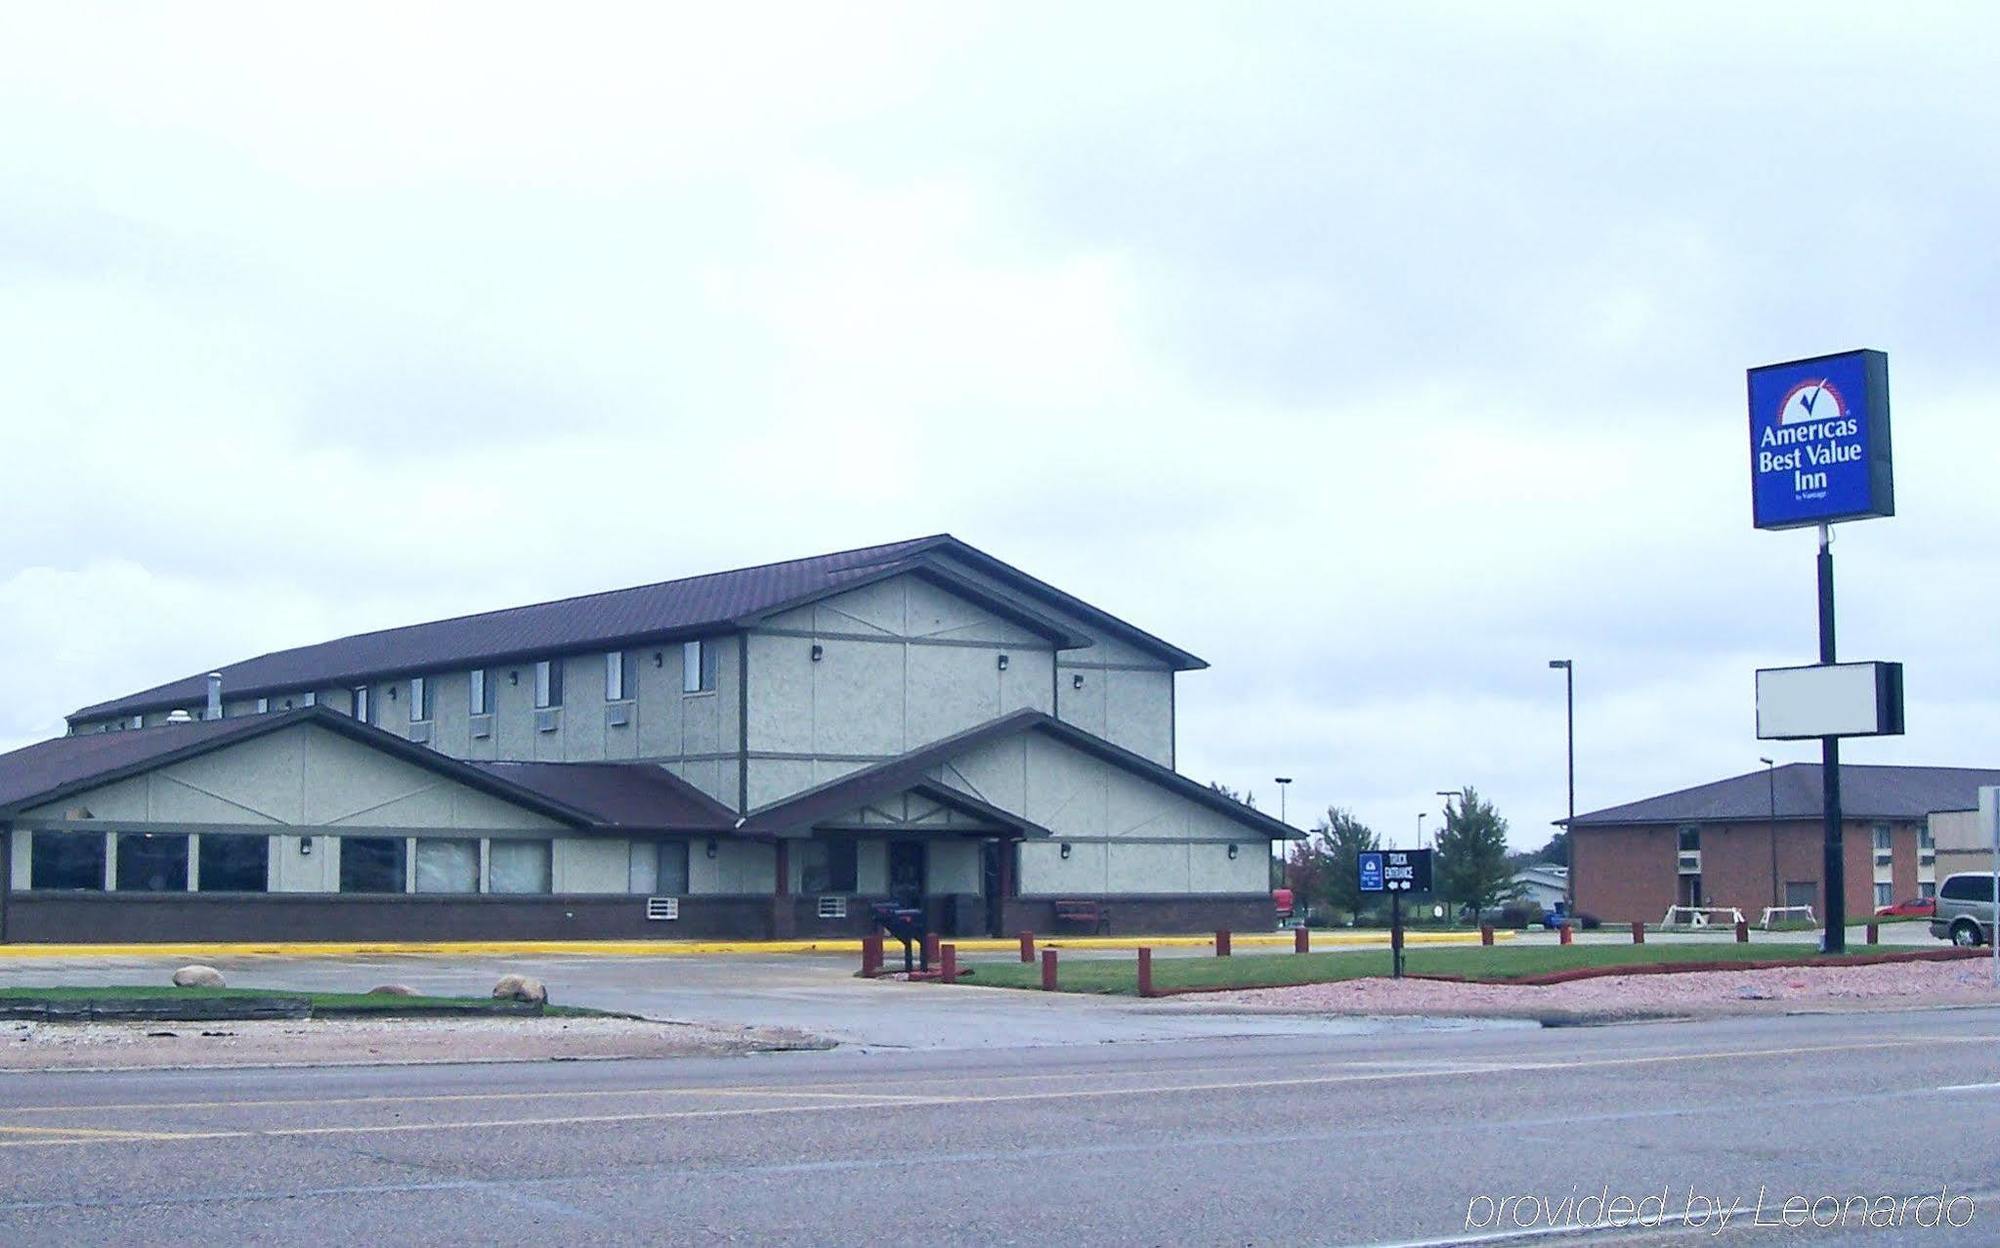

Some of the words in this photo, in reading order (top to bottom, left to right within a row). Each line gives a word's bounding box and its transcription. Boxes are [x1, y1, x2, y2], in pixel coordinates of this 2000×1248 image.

[1760, 418, 1858, 448] Americas
[1759, 447, 1802, 473] Best
[1806, 440, 1862, 466] Value
[1795, 470, 1827, 492] Inn
[1384, 866, 1414, 879] ENTRANCE
